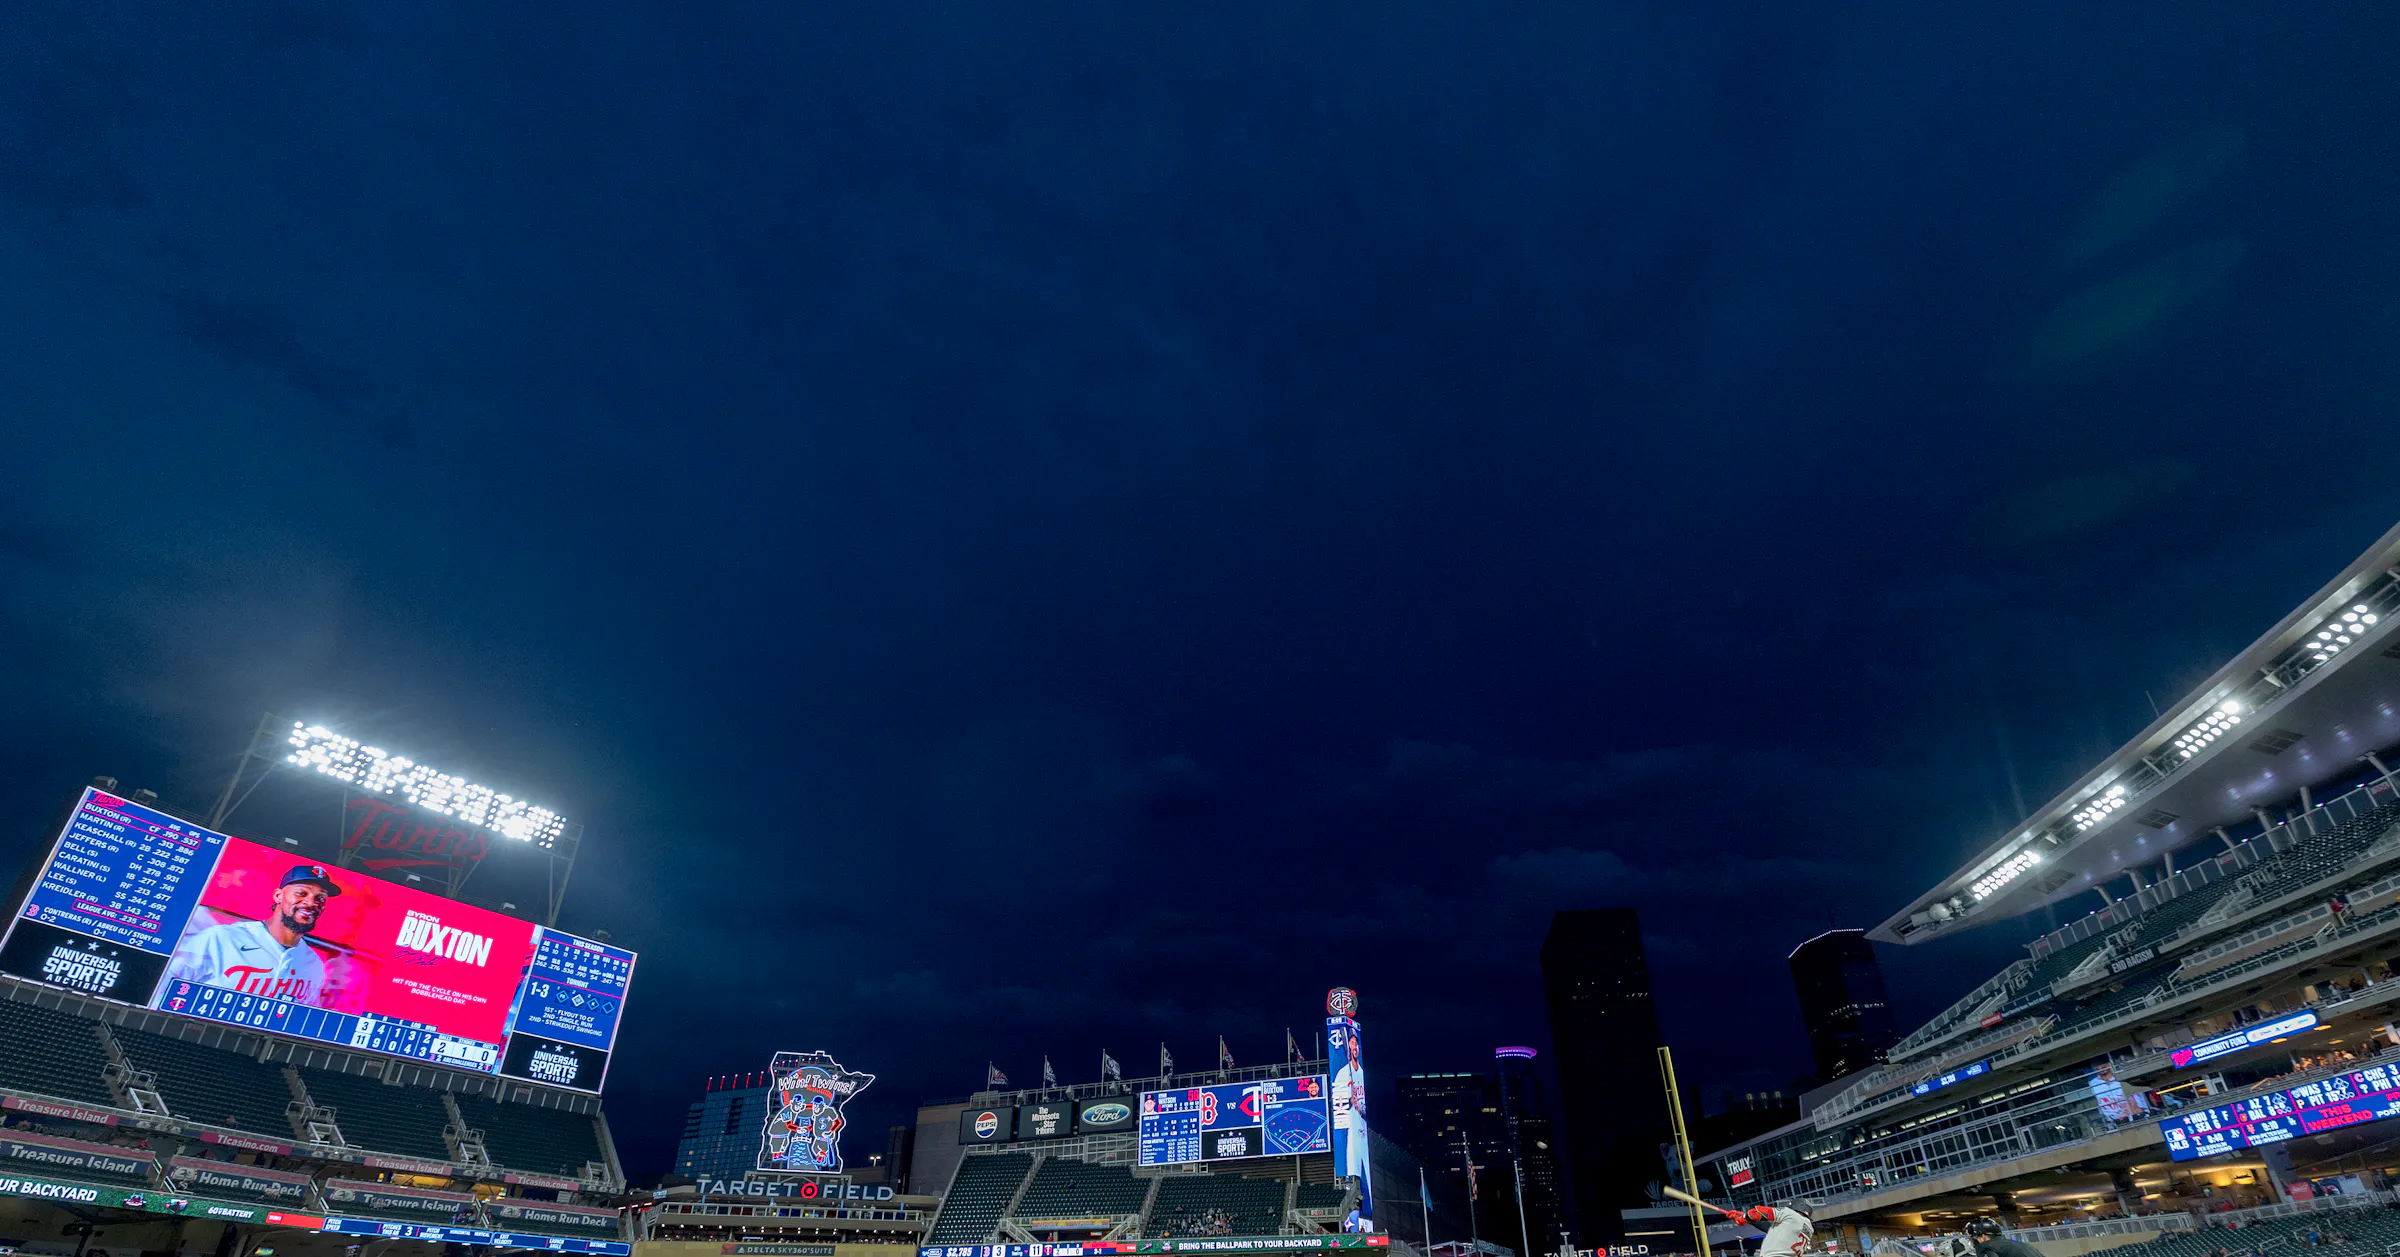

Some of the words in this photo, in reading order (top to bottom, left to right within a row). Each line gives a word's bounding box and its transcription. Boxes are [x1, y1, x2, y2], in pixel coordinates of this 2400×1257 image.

[93, 791, 125, 808] Twins
[84, 803, 120, 820] BUXTON
[162, 830, 179, 840] .190
[342, 797, 488, 863] Twins
[79, 813, 113, 830] MARTIN
[158, 839, 174, 849] .313
[74, 822, 124, 844] KEASCHALL
[152, 849, 171, 859] .222
[69, 832, 107, 849] JEFFERS
[147, 858, 166, 869] .308
[64, 841, 86, 854] BELL
[143, 868, 161, 878] .278
[58, 851, 100, 869] CARATINI
[138, 877, 157, 887] .277
[53, 861, 96, 880] WALLNER
[134, 886, 151, 896] .213
[47, 871, 65, 882] LEE
[128, 897, 147, 906] .244
[42, 880, 87, 900] KREIDLER
[124, 906, 141, 915] .143
[44, 906, 82, 922] CONTRERAS
[96, 921, 118, 932] ABREU
[132, 931, 153, 942] STORY
[77, 902, 101, 916] LEAGUE
[119, 914, 137, 924] .235
[139, 920, 158, 930] .693
[406, 910, 440, 923] BYRON
[395, 916, 493, 967] BUXTON
[583, 942, 605, 953] SEASON
[51, 946, 121, 973] UNIVERSAL
[2111, 959, 2127, 973] END
[2125, 949, 2155, 968] RACISM
[43, 956, 118, 988] SPORTS
[45, 973, 106, 993] AUCTIONS
[530, 982, 550, 998] 1-3
[566, 977, 589, 989] TONIGHT
[411, 988, 453, 1002] BOBBLEHEAD
[419, 983, 431, 991] THE
[432, 986, 452, 996] CYCLE
[472, 996, 488, 1004] OWN
[557, 1010, 579, 1019] FLYOUT
[545, 1019, 576, 1031] STRIKEOUT
[356, 1035, 366, 1045] 11
[372, 1038, 380, 1047] 9
[388, 1041, 396, 1050] 0
[403, 1044, 411, 1054] 4
[419, 1047, 426, 1057] 3
[2193, 1038, 2232, 1058] COMMUNITY
[2230, 1035, 2248, 1047] FUND
[534, 1050, 579, 1068] UNIVERSAL
[529, 1059, 577, 1079] SPORTS
[2362, 1067, 2386, 1082] CHC
[2388, 1064, 2399, 1075] 3
[532, 1072, 571, 1084] AUCTIONS
[778, 1075, 812, 1091] Win!
[812, 1075, 856, 1094] Twins!
[2372, 1077, 2392, 1092] PHI
[1263, 1086, 1284, 1094] BUXTON
[2298, 1083, 2321, 1097] WAS
[2322, 1080, 2332, 1092] 5
[1158, 1097, 1176, 1105] WATSON
[1267, 1094, 1277, 1102] 1-3
[2249, 1098, 2262, 1110] AZ
[2263, 1096, 2271, 1106] 7
[2308, 1092, 2325, 1107] PIT
[17, 1099, 71, 1118] Treasure
[71, 1111, 110, 1124] Island
[1031, 1112, 1060, 1121] Minnesota
[1038, 1107, 1049, 1115] The
[1091, 1108, 1121, 1121] Ford
[1201, 1092, 1218, 1126] B
[2189, 1111, 2208, 1125] HOU
[2210, 1109, 2218, 1119] 2
[2221, 1110, 2229, 1121] F
[2247, 1108, 2267, 1121] BAL
[2269, 1106, 2277, 1116] 8
[2318, 1104, 2352, 1118] THIS
[1043, 1120, 1056, 1128] Star
[2196, 1121, 2215, 1133] SEA
[2214, 1119, 2222, 1129] 6
[2261, 1120, 2279, 1132] 9:10
[2307, 1110, 2373, 1131] WEEKEND
[1035, 1127, 1056, 1135] Tribune
[1217, 1136, 1247, 1145] UNIVERSAL
[1217, 1143, 1247, 1154] SPORTS
[2170, 1140, 2190, 1152] MLB
[11, 1144, 84, 1167] Treasure
[87, 1156, 137, 1174] Island
[375, 1158, 415, 1171] Treasure
[416, 1164, 445, 1175] Island
[1727, 1156, 1751, 1175] TRULY
[20, 1182, 98, 1202] BACKYARD
[198, 1172, 240, 1188] Home
[242, 1178, 267, 1192] Run
[269, 1182, 303, 1197] Deck
[696, 1179, 798, 1197] TARGET
[822, 1184, 894, 1201] FIELD
[421, 1200, 460, 1213] Island
[525, 1210, 557, 1222] Home
[558, 1213, 579, 1224] Run
[581, 1215, 608, 1227] Deck
[404, 1226, 413, 1236] 3
[946, 1247, 973, 1257] $2,785
[996, 1247, 1002, 1256] 3
[1032, 1246, 1040, 1255] 11
[1179, 1241, 1201, 1250] BRING
[1201, 1241, 1215, 1249] THE
[1215, 1240, 1253, 1249] BALLPARK
[1252, 1239, 1262, 1248] TO
[1262, 1239, 1284, 1248] YOUR
[1283, 1239, 1322, 1248] BACKYARD
[1609, 1244, 1649, 1257] FIELD
